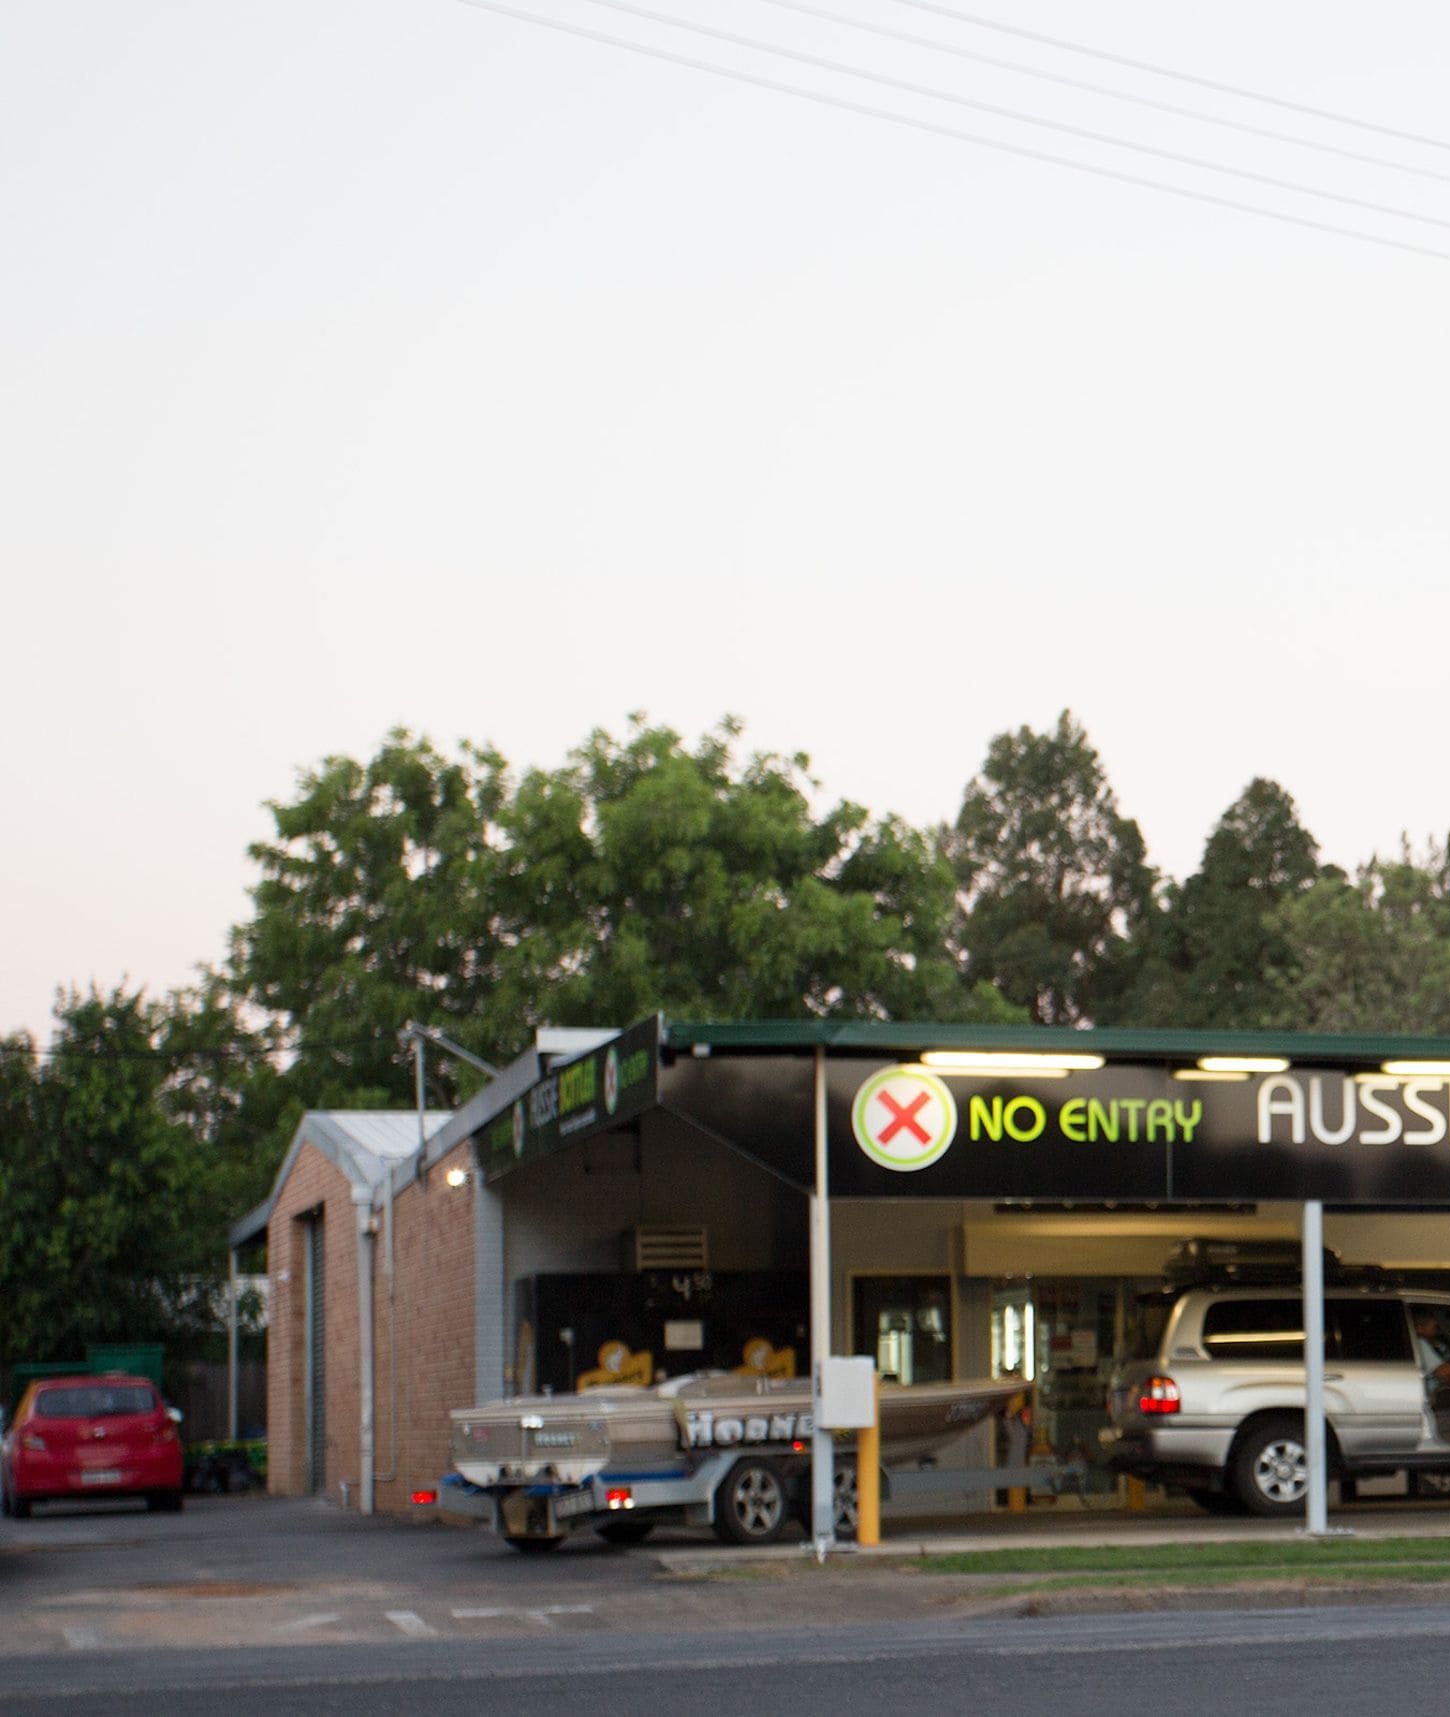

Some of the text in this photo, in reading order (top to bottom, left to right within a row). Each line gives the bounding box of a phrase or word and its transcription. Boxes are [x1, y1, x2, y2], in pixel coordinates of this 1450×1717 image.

[969, 1095, 1202, 1143] NO ENTRY
[680, 1411, 814, 1449] HORNE
